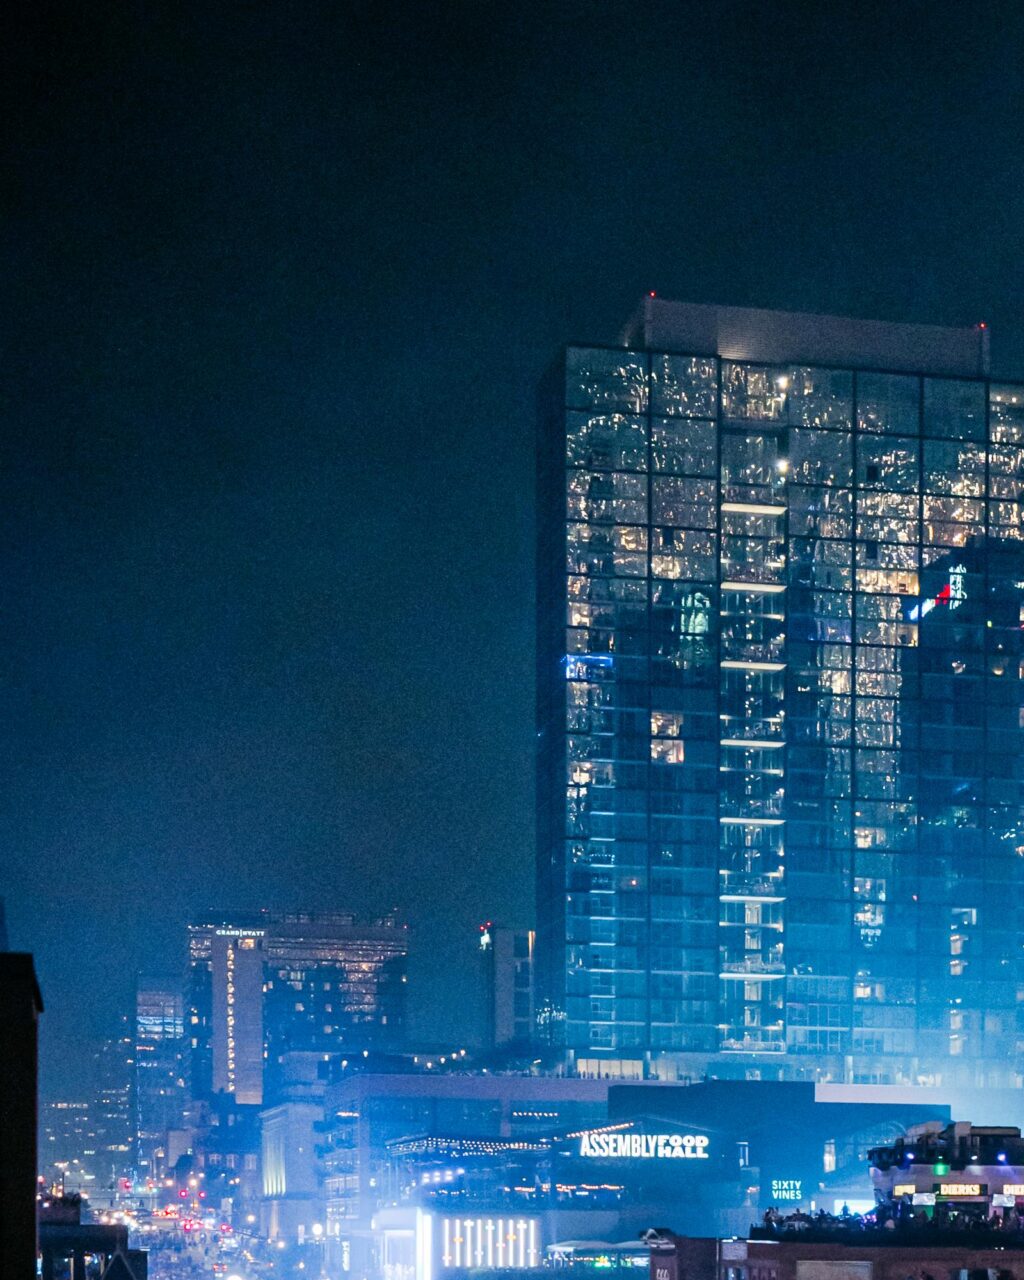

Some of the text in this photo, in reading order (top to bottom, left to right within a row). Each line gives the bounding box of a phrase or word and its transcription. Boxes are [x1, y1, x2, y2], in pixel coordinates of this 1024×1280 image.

[580, 1134, 657, 1158] ASSEMBLY
[657, 1135, 709, 1147] FOOD
[657, 1147, 709, 1158] HALL
[772, 1180, 802, 1190] SIXTY
[940, 1184, 980, 1195] DIERKS
[772, 1190, 802, 1200] VINES
